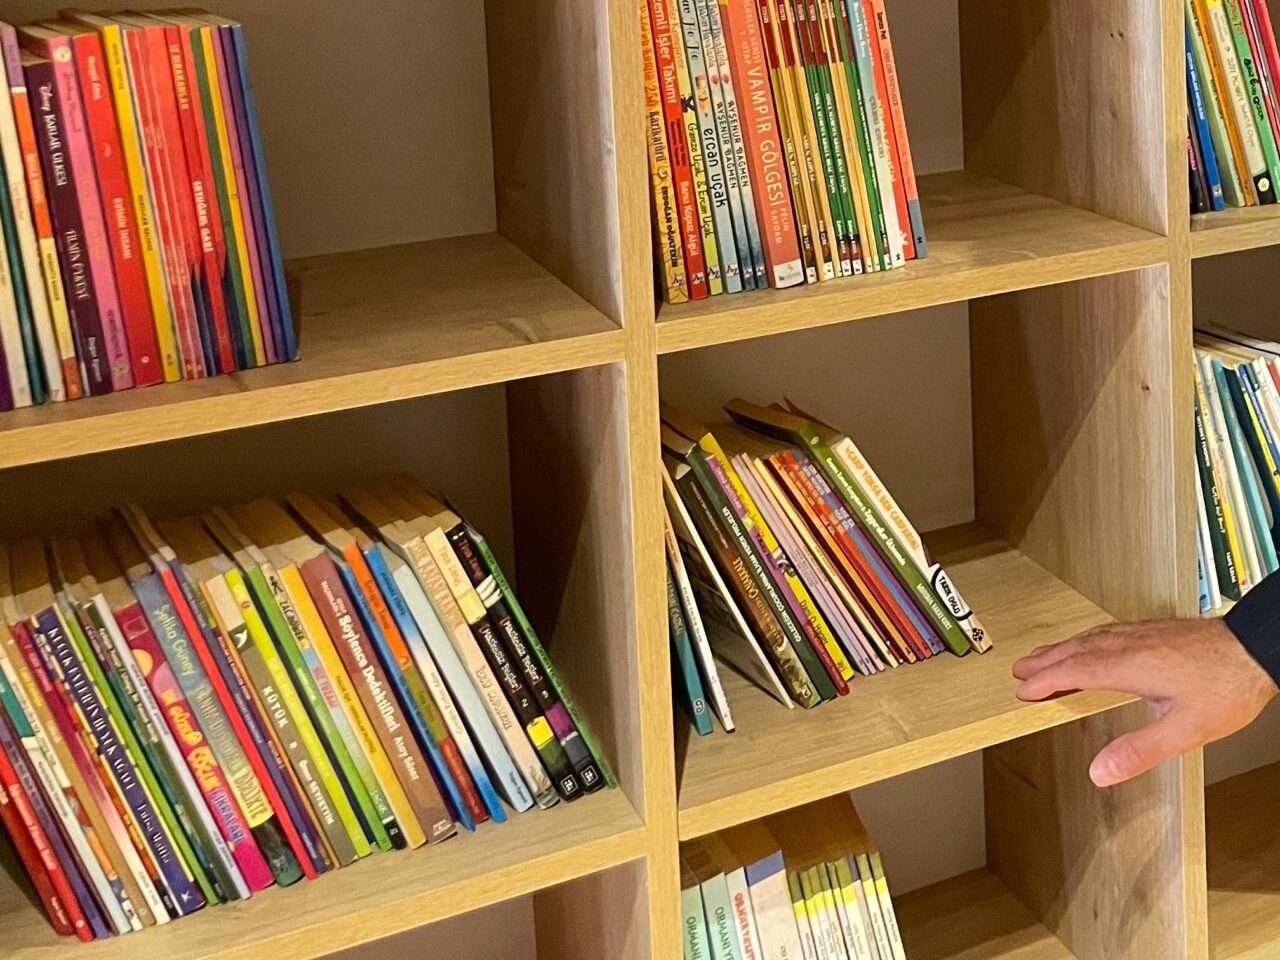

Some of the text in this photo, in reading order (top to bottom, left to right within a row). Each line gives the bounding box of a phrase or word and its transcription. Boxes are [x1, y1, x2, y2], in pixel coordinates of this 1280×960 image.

[660, 63, 679, 103] Takımı
[45, 115, 62, 149] KARLAR
[716, 102, 732, 145] AYŞENUR
[727, 100, 744, 144] AYŞENUR
[747, 66, 785, 205] VAMPİR GÖLGESİ
[686, 122, 702, 152] Gamze
[695, 190, 710, 212] Ercan
[704, 128, 728, 208] ercan uçak
[681, 181, 695, 202] Banu
[684, 205, 698, 230] Kopuz
[770, 210, 782, 244] SAYDAM
[337, 615, 372, 667] Söylence
[361, 666, 400, 732] Dedektifleri
[714, 906, 730, 950] ORMANI
